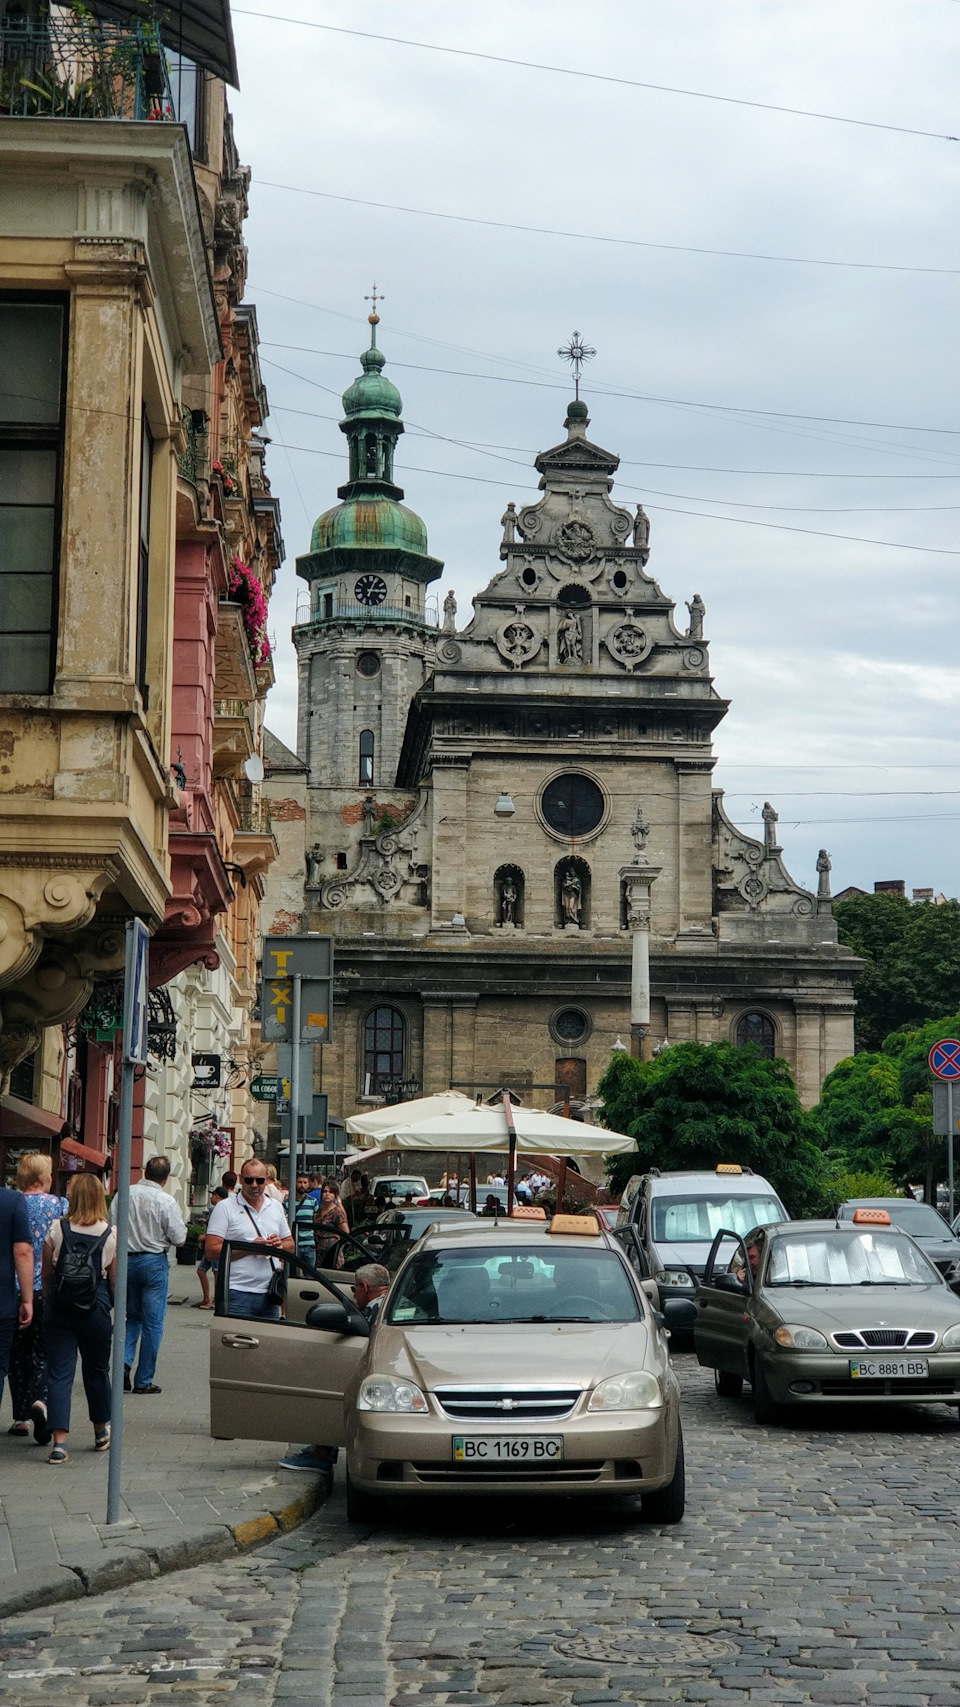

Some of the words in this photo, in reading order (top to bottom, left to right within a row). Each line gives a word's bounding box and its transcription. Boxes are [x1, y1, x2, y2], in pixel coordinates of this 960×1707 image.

[270, 951, 293, 1024] TAXI
[859, 1364, 876, 1376] BC
[878, 1363, 905, 1375] 8881
[907, 1363, 924, 1375] BB
[465, 1441, 488, 1457] BC
[493, 1441, 529, 1457] 1169
[534, 1441, 557, 1457] BC
